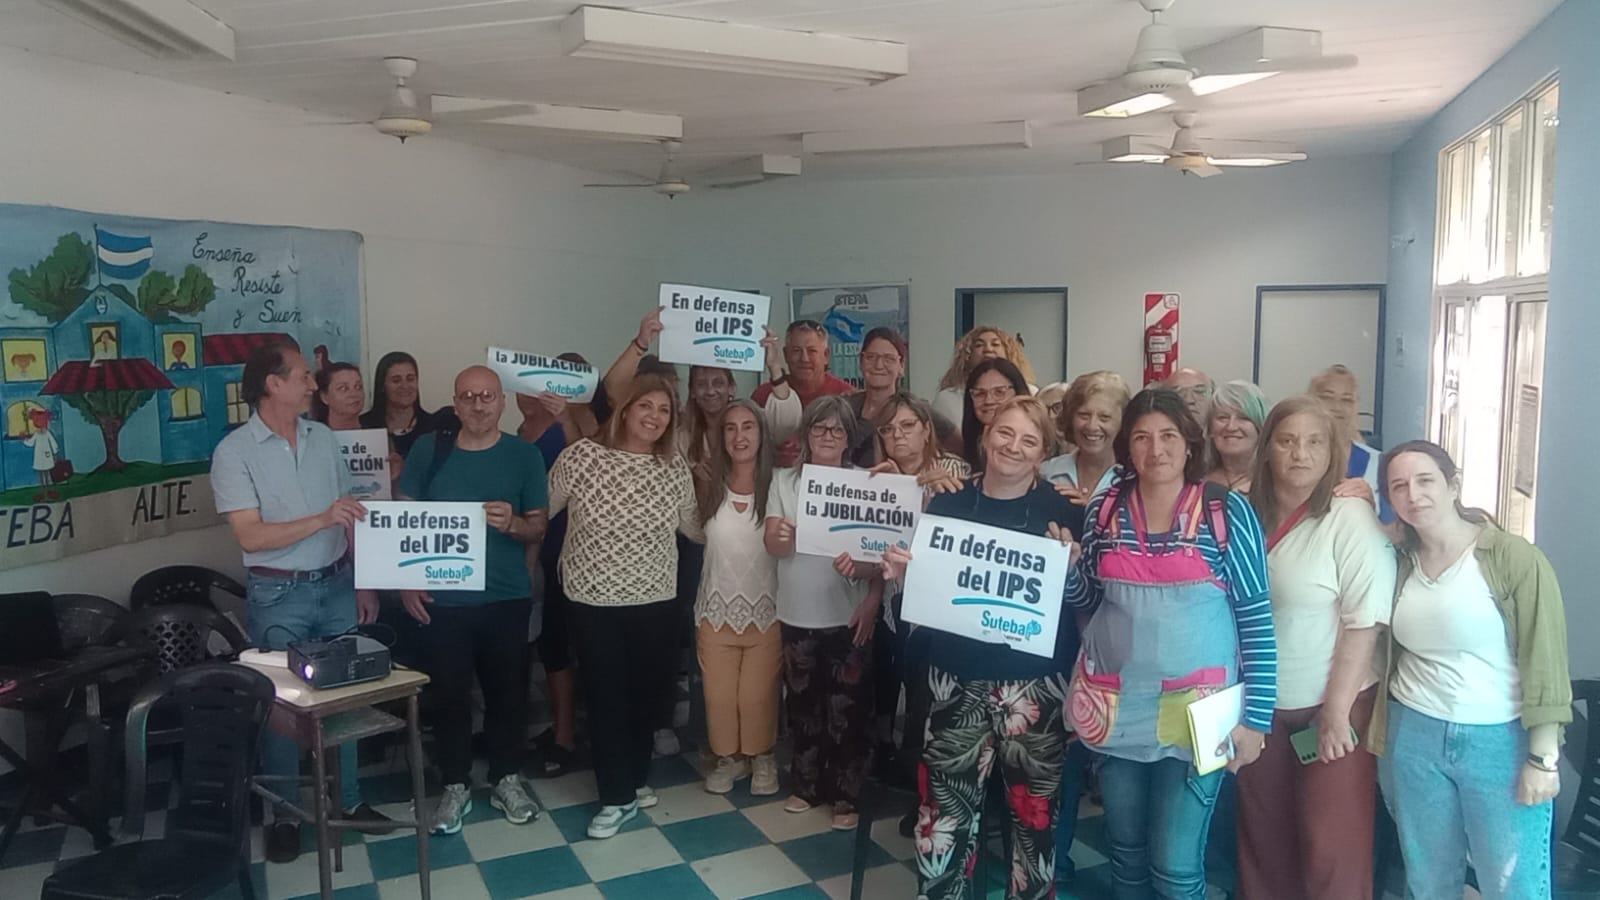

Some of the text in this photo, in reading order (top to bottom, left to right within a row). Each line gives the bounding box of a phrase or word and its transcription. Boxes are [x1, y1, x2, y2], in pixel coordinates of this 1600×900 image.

[192, 232, 256, 264] Enseña
[231, 266, 284, 297] Resiste
[671, 292, 755, 315] En defensa
[232, 309, 245, 329] y
[695, 316, 753, 337] del IPS
[495, 351, 508, 363] la
[713, 344, 745, 360] Suteba
[352, 441, 367, 454] de
[808, 479, 897, 504] En defensa de
[370, 510, 470, 529] En defensa
[806, 501, 914, 528] la JUBILACIÓN
[400, 533, 470, 554] del IPS
[929, 526, 1046, 574] En defensa
[425, 565, 462, 579] Suteba
[957, 565, 1043, 605] del IPS
[981, 609, 1026, 637] Suteba
